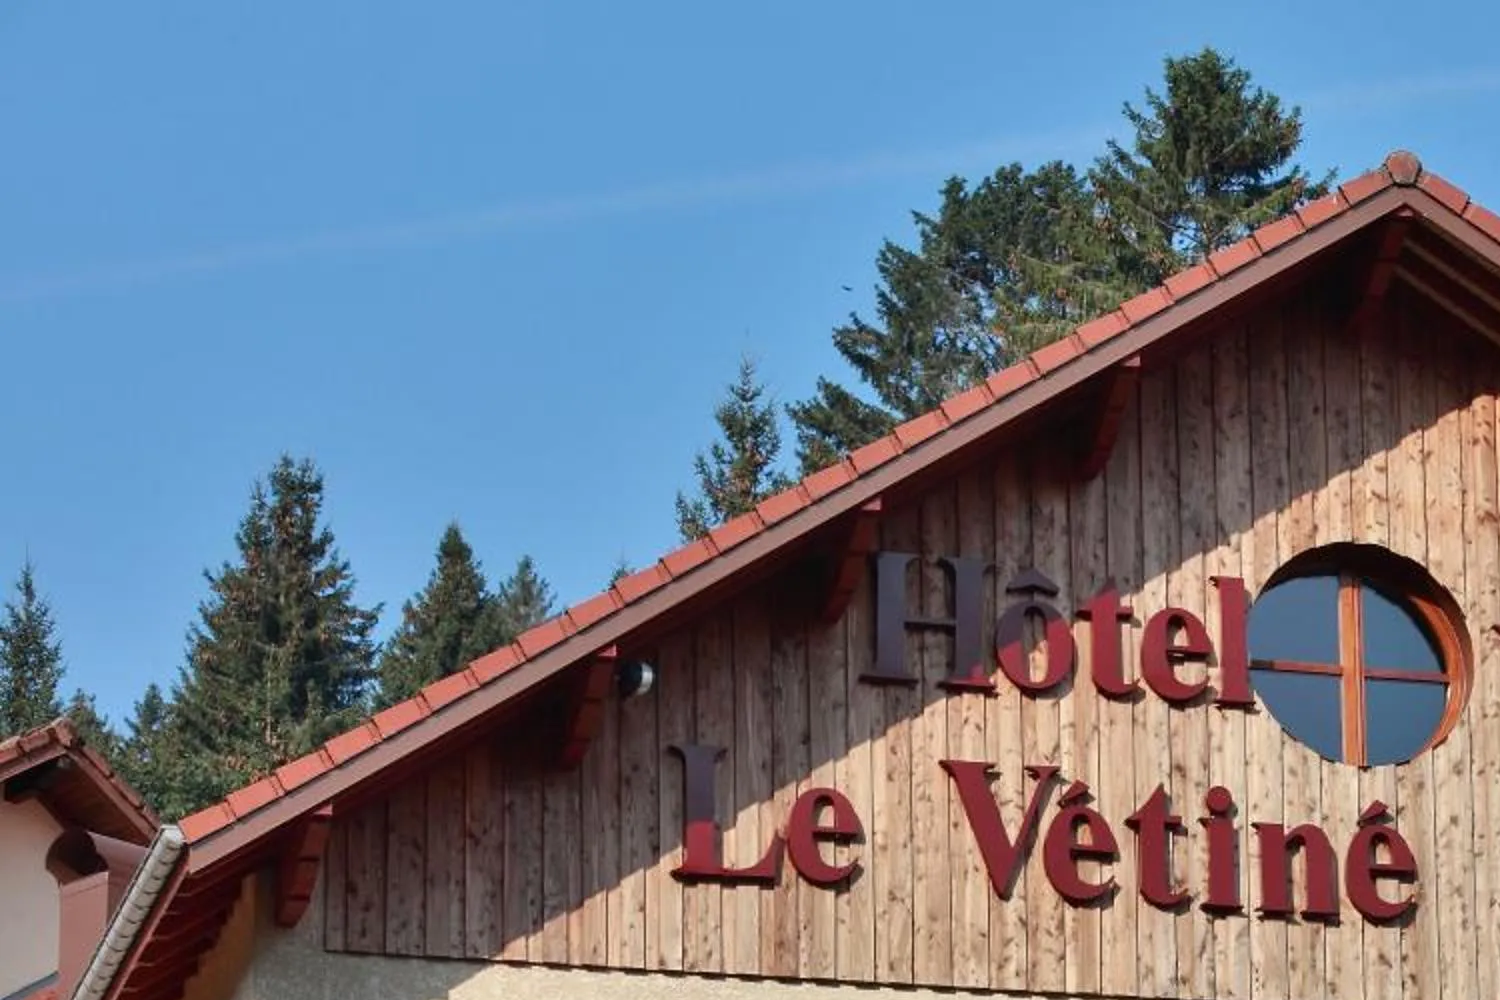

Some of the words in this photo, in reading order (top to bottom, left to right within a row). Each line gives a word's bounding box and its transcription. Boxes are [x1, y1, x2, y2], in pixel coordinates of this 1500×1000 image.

[860, 551, 1256, 709] Hôtel
[669, 745, 863, 886] Le
[940, 760, 1419, 922] Vétiné
